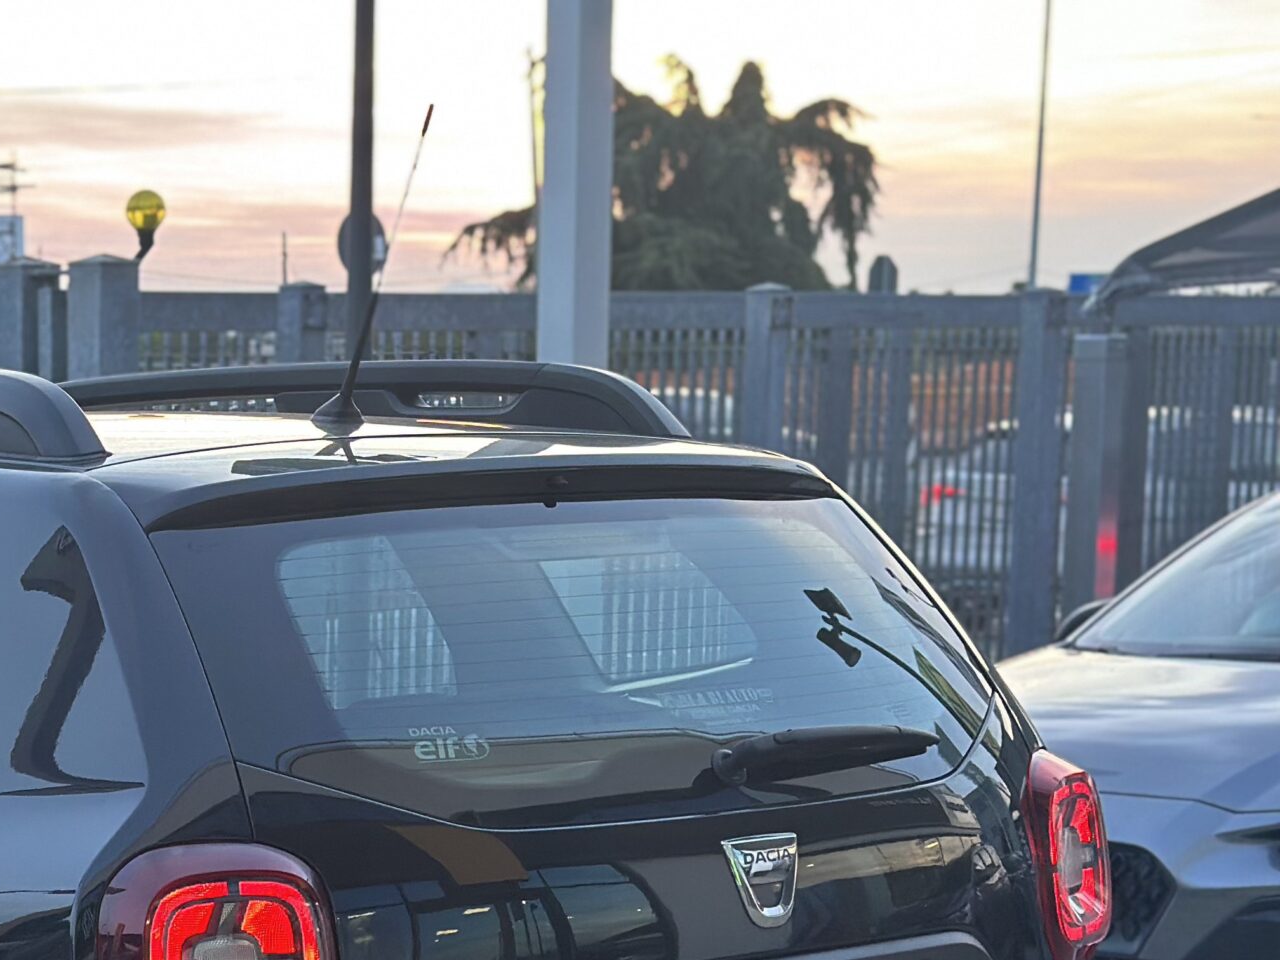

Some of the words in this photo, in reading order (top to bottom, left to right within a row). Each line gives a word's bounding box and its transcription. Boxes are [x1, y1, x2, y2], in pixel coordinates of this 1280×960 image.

[408, 726, 456, 737] DACIA
[414, 736, 459, 760] elf
[743, 848, 792, 865] DACIA
